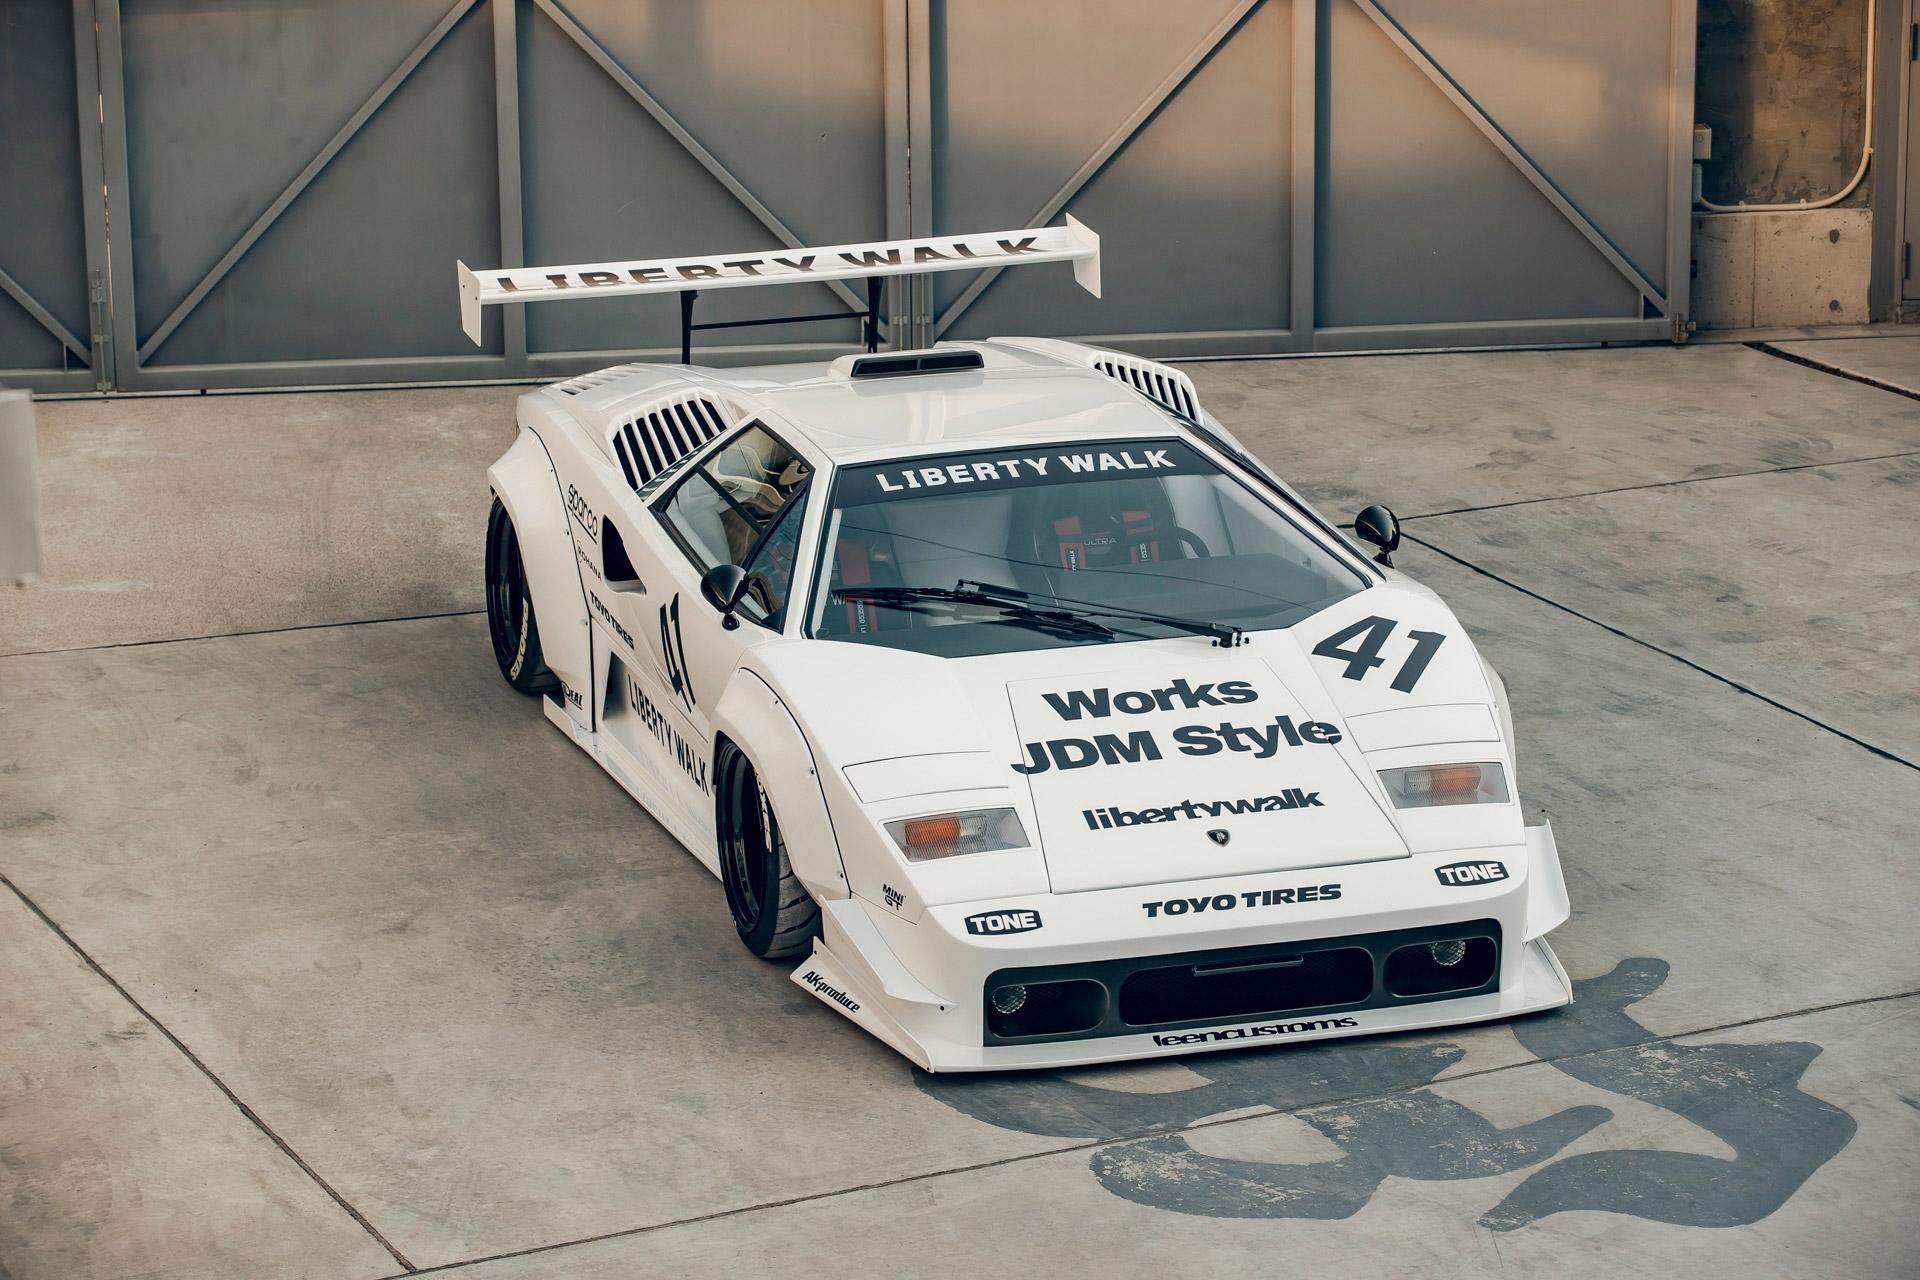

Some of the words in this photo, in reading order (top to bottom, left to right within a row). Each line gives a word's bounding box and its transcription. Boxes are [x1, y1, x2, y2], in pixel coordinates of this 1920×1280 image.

[497, 255, 815, 293] LIBERTY
[838, 237, 1047, 269] WALK
[876, 456, 1048, 492] LIBERTY
[1057, 449, 1177, 472] WALK
[569, 483, 598, 537] sparco
[590, 590, 610, 623] TOYO
[611, 615, 635, 650] TIRES
[660, 592, 696, 714] 41
[1311, 615, 1447, 694] 41
[1041, 678, 1258, 721] Works
[628, 674, 672, 756] LIBERTY
[673, 730, 710, 797] WALK
[1010, 730, 1163, 775] JDM
[1172, 715, 1343, 759] Style
[1082, 788, 1326, 831] libertywalk
[882, 883, 904, 903] MINI
[1439, 862, 1504, 885] TONE
[885, 895, 902, 911] GT
[968, 911, 1037, 933] TONE
[1142, 898, 1237, 918] TOYO
[1241, 884, 1342, 908] TIRES
